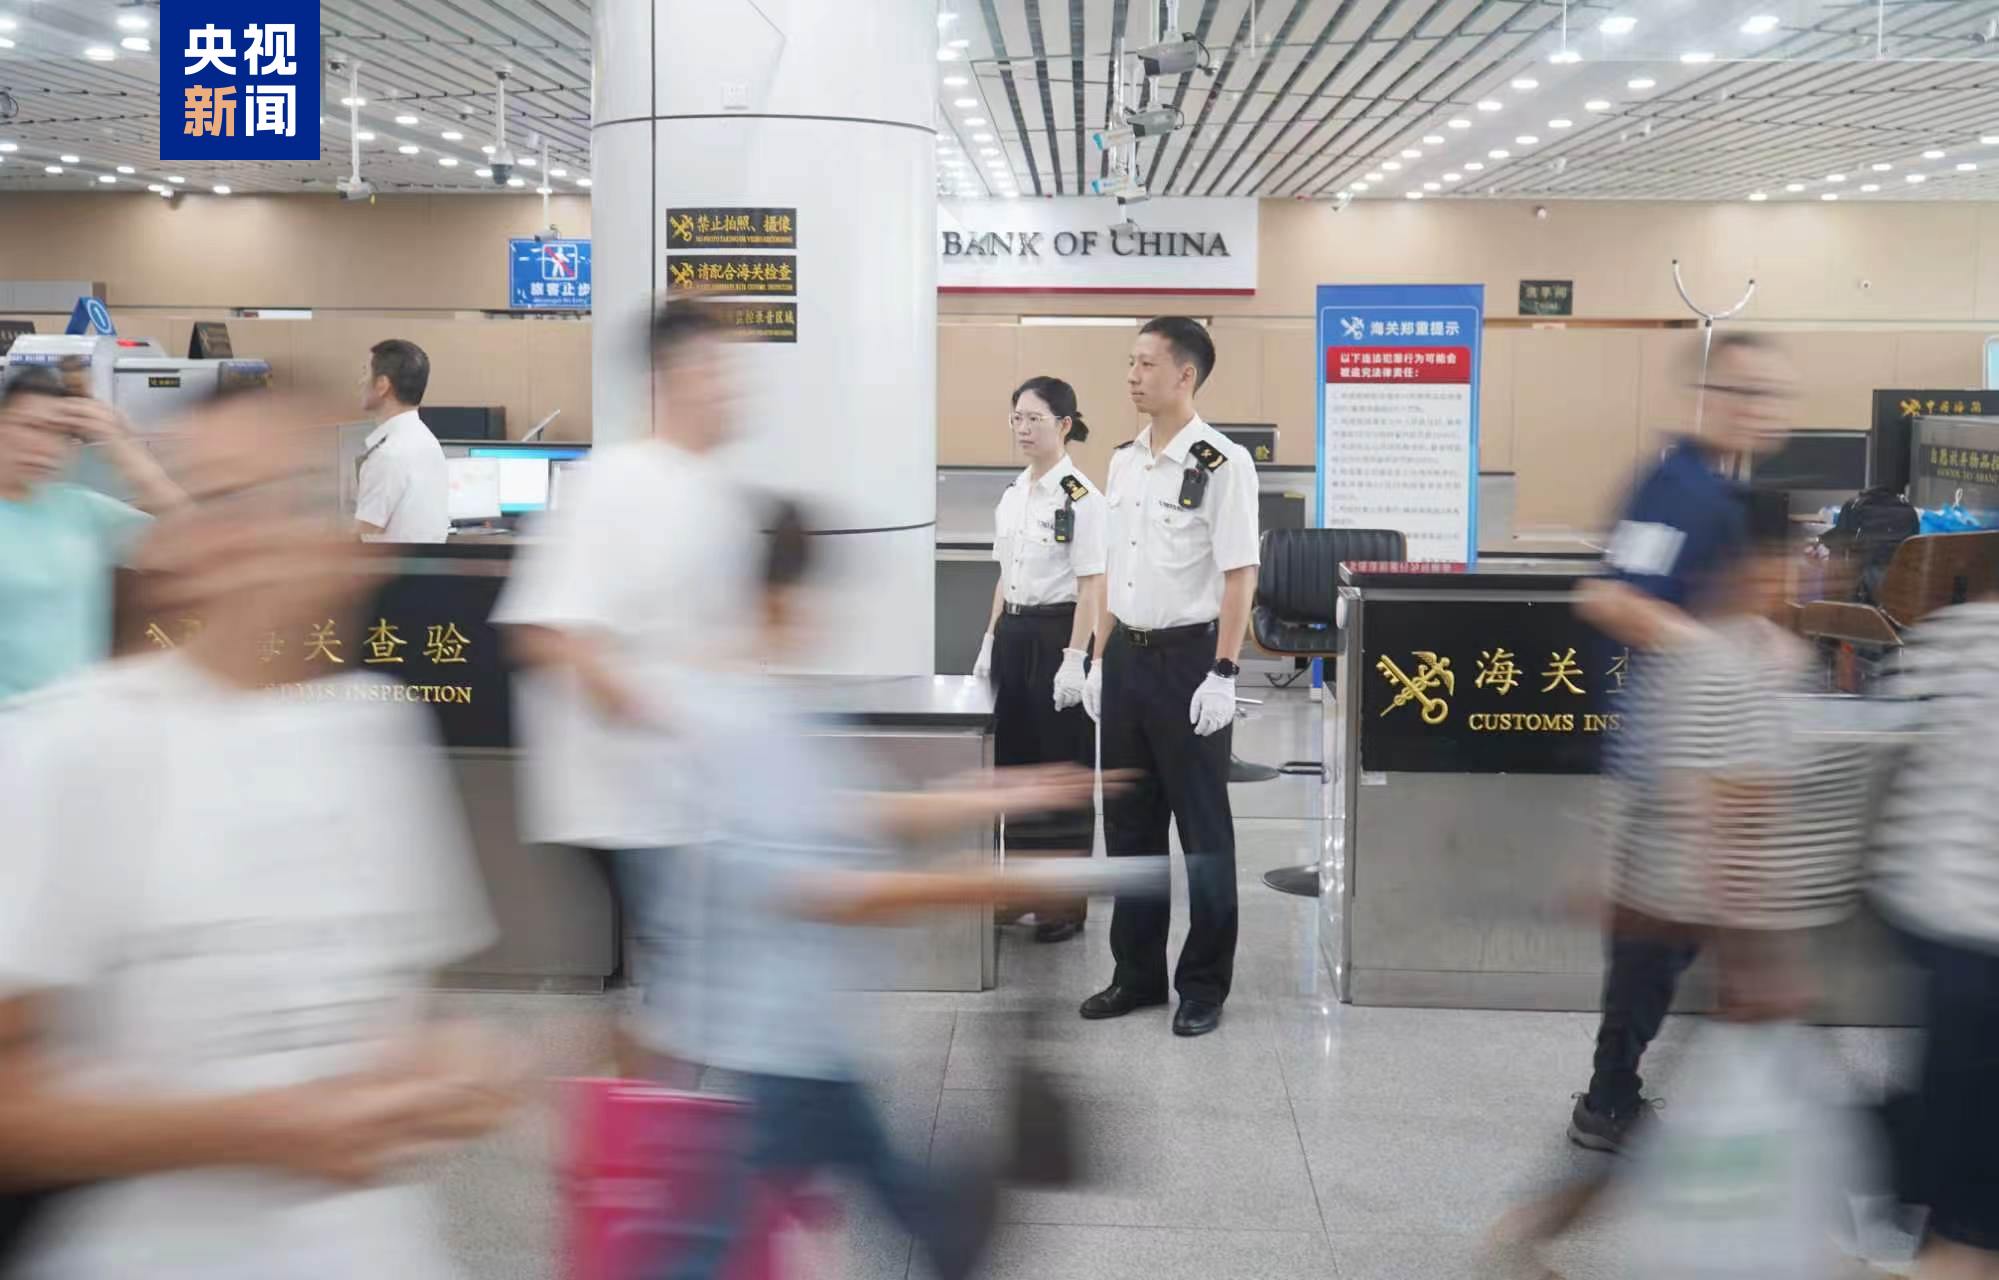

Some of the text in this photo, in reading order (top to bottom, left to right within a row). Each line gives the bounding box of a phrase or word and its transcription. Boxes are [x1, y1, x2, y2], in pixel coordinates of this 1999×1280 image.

[698, 214, 791, 233] 禁止拍照、摄像
[941, 229, 1231, 257] BANK OF CHINA
[697, 262, 792, 280] 请配合海关检查
[1370, 321, 1460, 336] 海关郑重提示
[344, 684, 472, 704] INSPECTION
[1468, 713, 1626, 731] CUSTOMS INS
